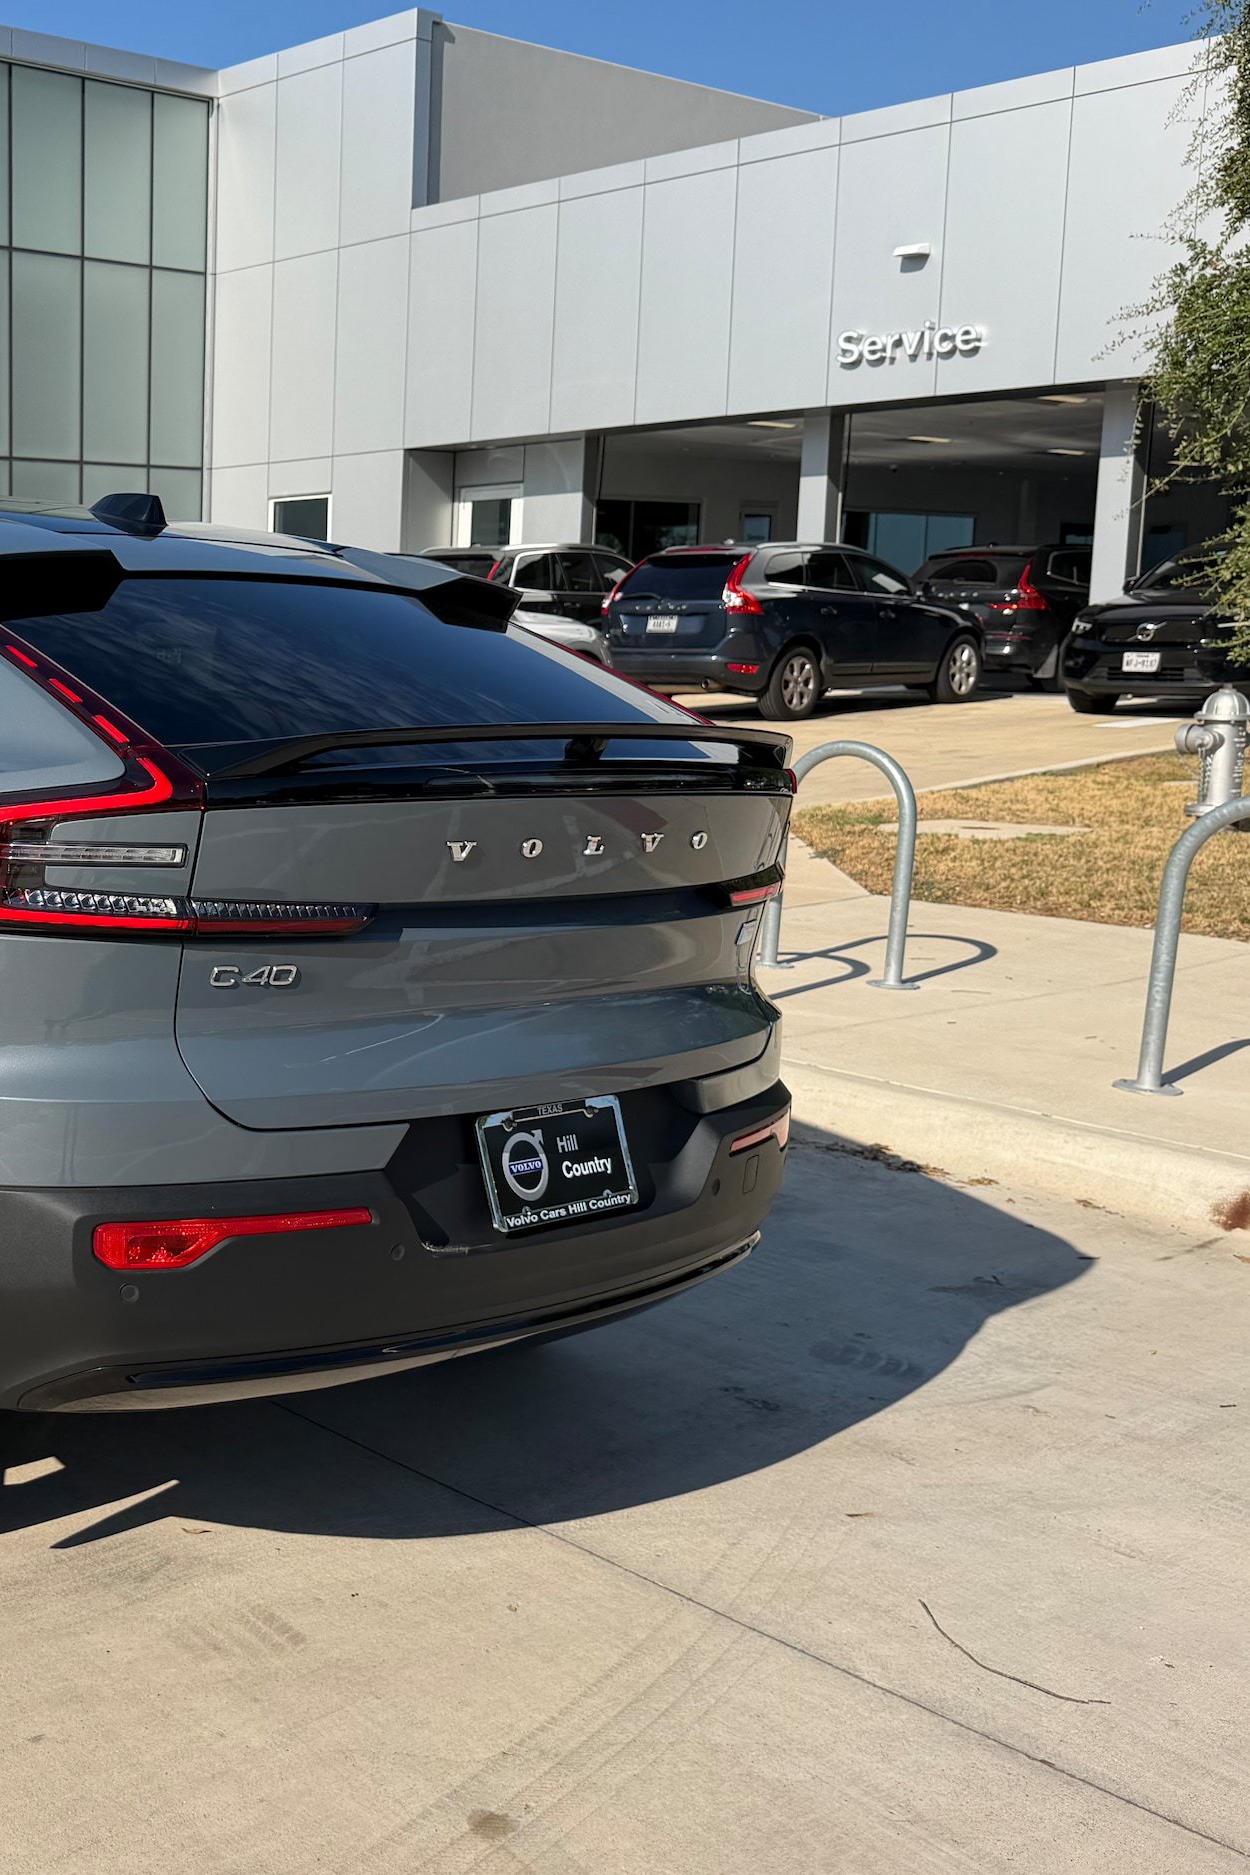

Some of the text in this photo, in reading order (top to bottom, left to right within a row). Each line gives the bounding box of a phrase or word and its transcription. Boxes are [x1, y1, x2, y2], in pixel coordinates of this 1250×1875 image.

[836, 319, 978, 364] Service
[446, 830, 709, 862] VOLVO
[210, 964, 298, 987] C40
[536, 1103, 564, 1116] TEXAS
[556, 1133, 579, 1153] Hill
[510, 1159, 543, 1174] VOLVO
[562, 1156, 612, 1179] Country
[506, 1193, 631, 1228] Volvo Cars Hill Country
